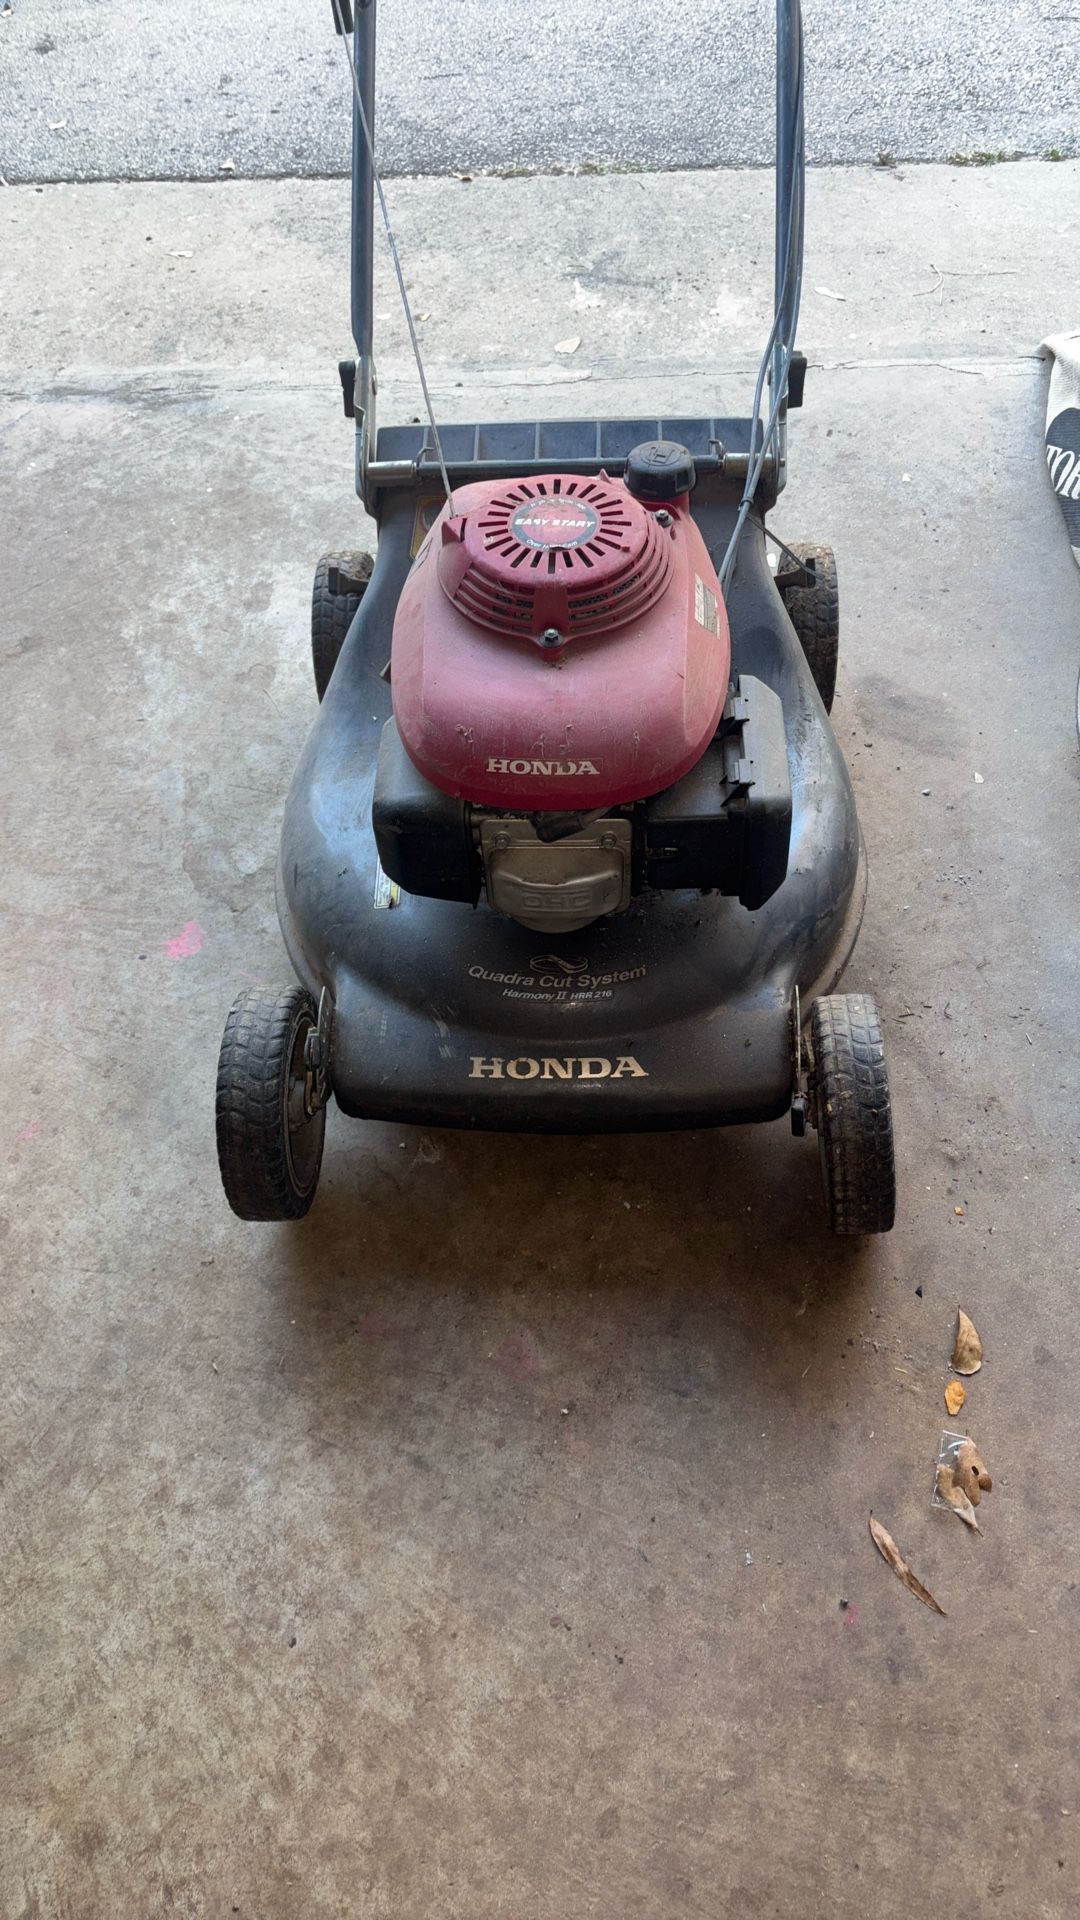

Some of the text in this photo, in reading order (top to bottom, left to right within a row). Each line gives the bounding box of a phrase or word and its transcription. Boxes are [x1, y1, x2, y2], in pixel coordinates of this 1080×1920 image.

[486, 758, 601, 776] HONDA
[468, 965, 646, 989] Quadra Cut System
[502, 988, 613, 1001] Harmony II HRR 216
[468, 1056, 649, 1080] HONDA
